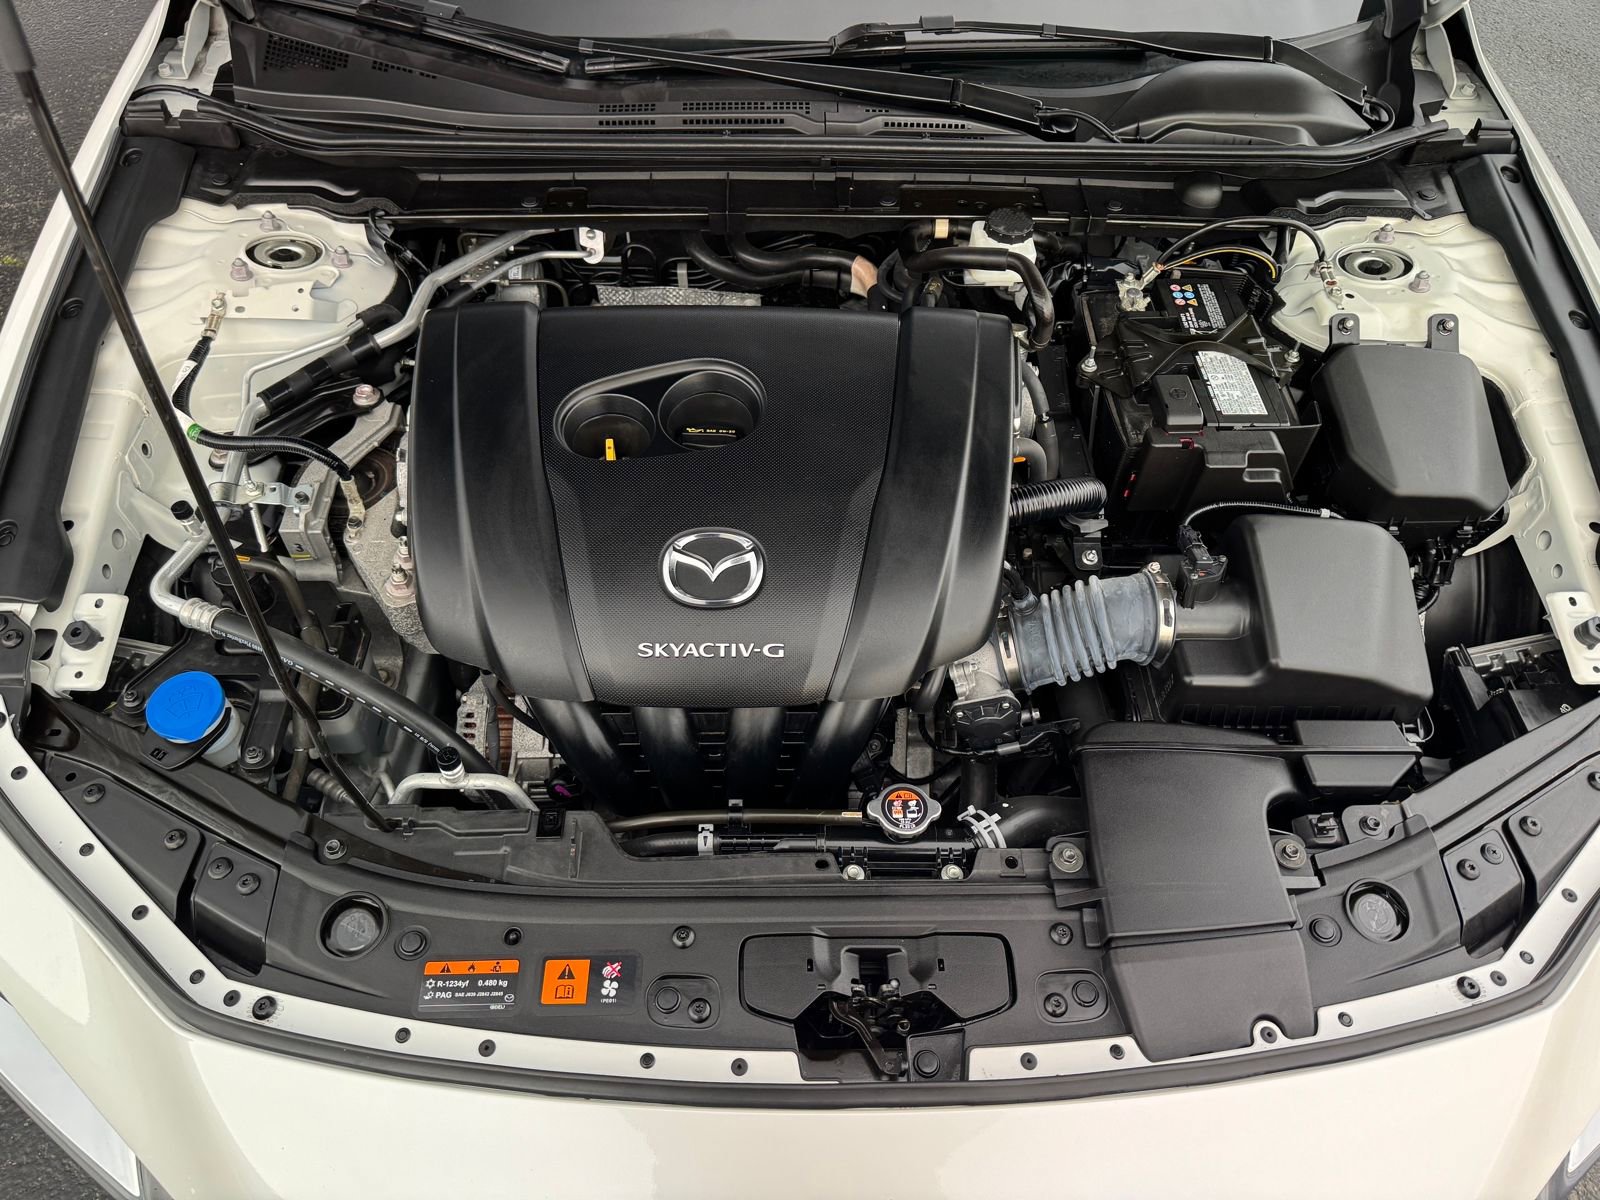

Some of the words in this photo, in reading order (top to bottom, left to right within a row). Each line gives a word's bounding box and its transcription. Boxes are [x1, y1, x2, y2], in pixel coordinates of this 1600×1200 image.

[294, 543, 305, 553] 3
[637, 642, 785, 658] SKYACTIV-G
[436, 979, 470, 989] R-1234yf
[477, 979, 498, 987] 0.480
[498, 979, 508, 988] kg
[435, 991, 453, 999] PAG
